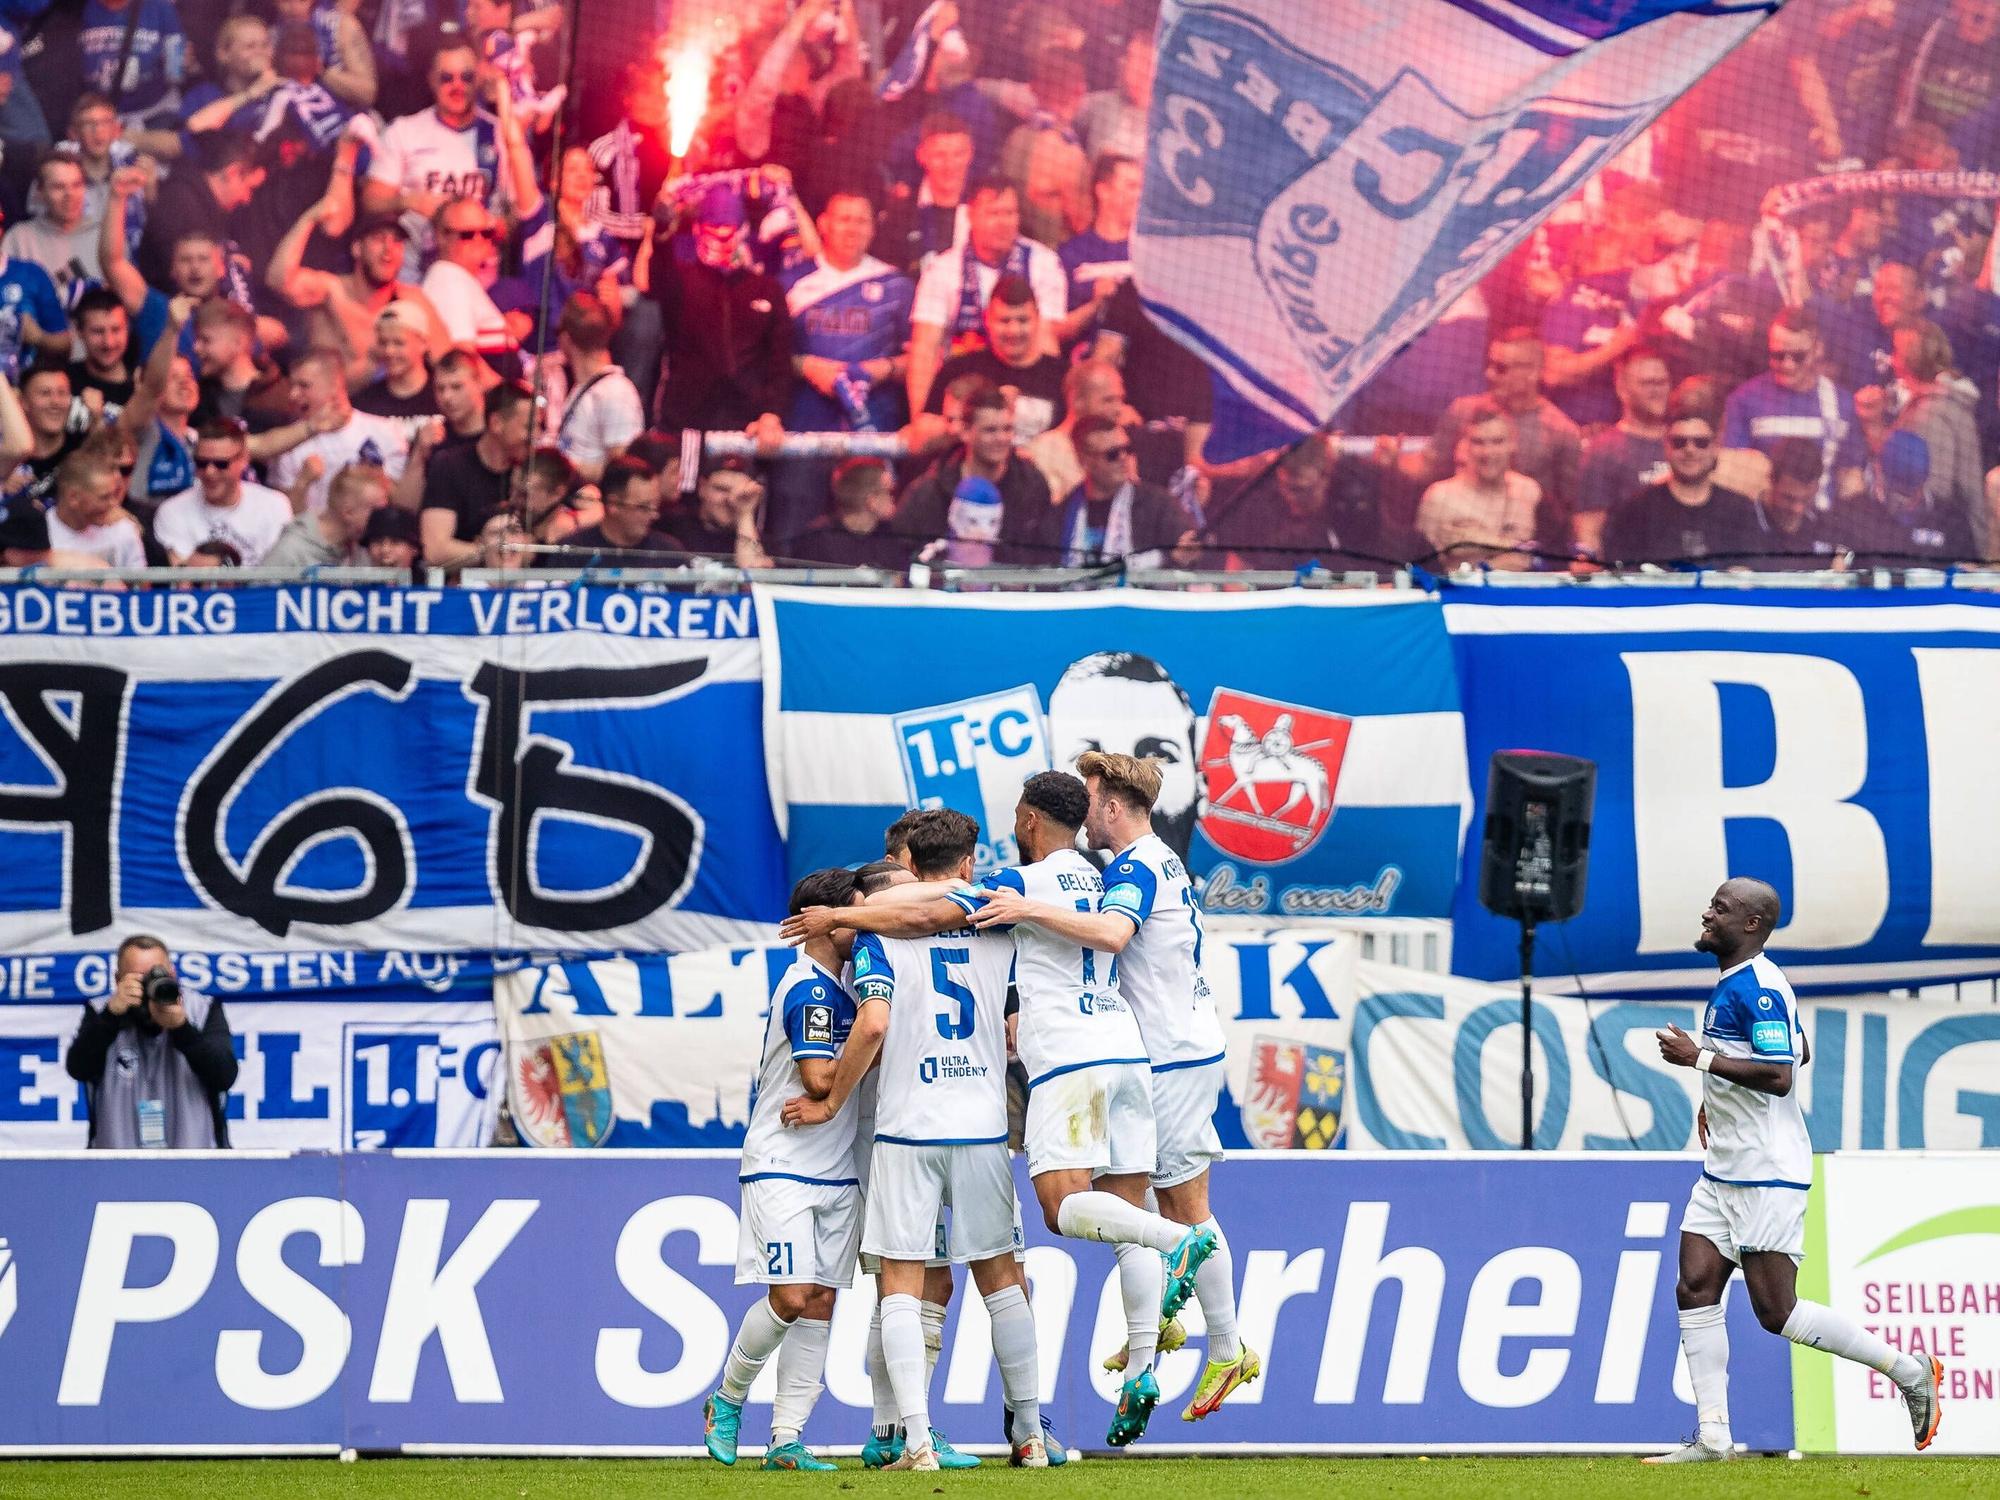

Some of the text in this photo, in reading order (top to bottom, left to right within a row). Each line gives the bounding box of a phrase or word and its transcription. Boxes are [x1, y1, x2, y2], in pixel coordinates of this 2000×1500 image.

[276, 588, 442, 633] NICHT
[469, 588, 750, 638] VERLOREN
[1203, 865, 1399, 911] bei uns!
[0, 955, 55, 999] IE
[75, 950, 355, 998] GSSTEN
[930, 947, 975, 1041] 5
[808, 1028, 830, 1038] bwin
[1756, 1029, 1785, 1040] SWM
[941, 1055, 970, 1066] ULTRA
[767, 1242, 792, 1275] 21
[57, 1196, 540, 1410] PSK
[1864, 1282, 2000, 1314] SEILBAH
